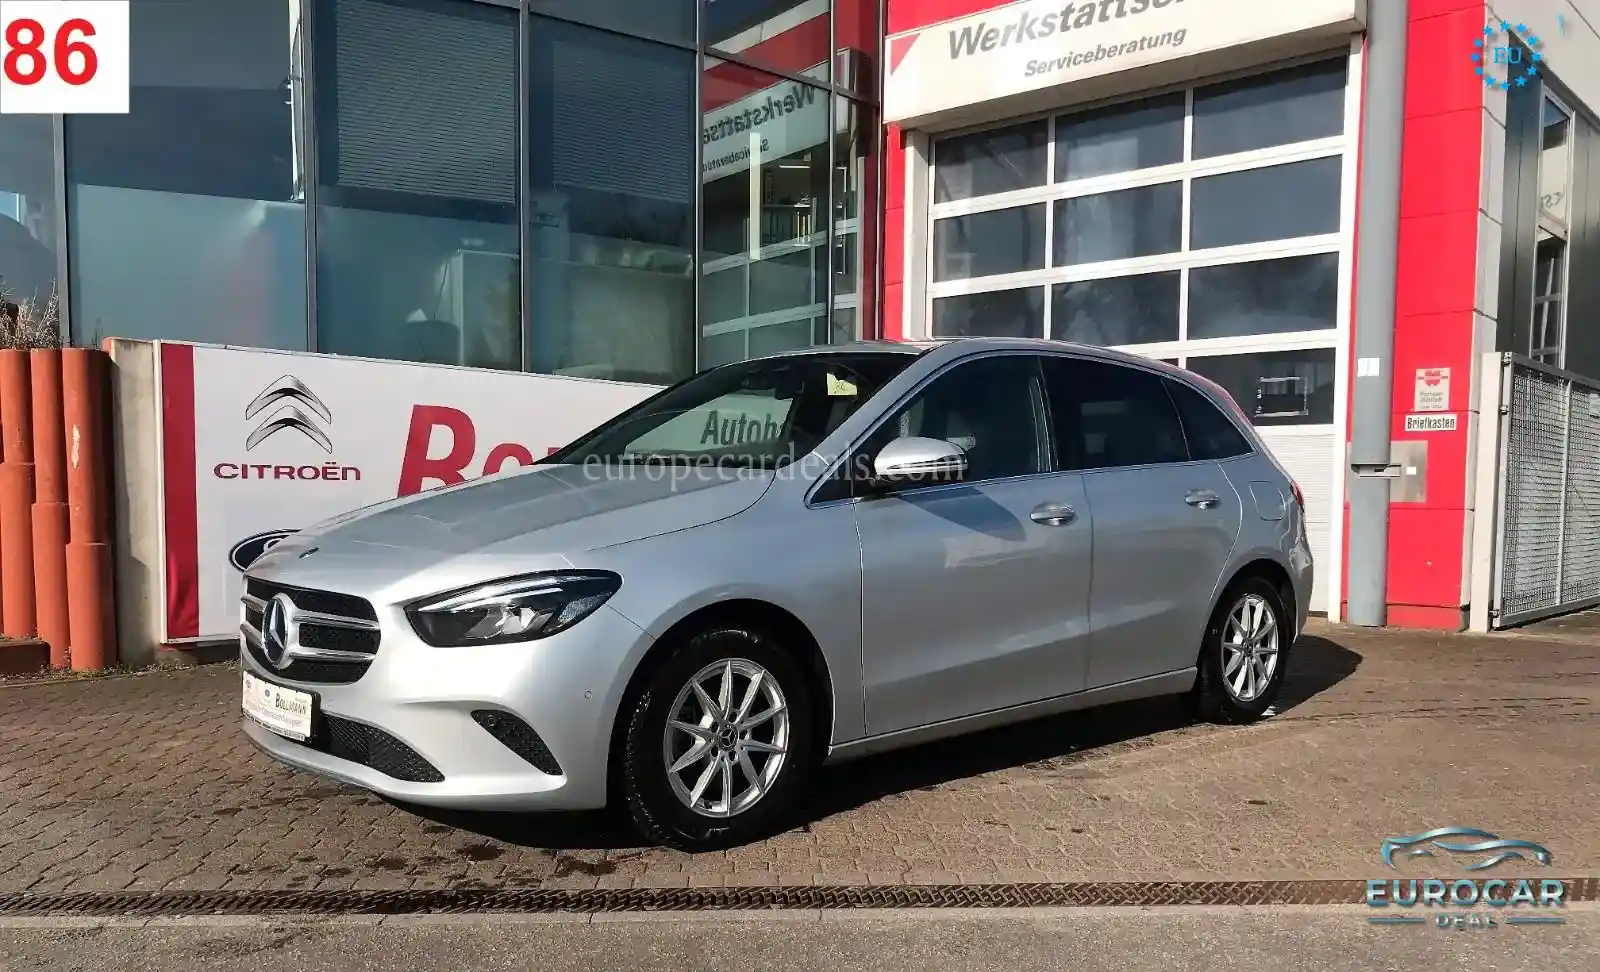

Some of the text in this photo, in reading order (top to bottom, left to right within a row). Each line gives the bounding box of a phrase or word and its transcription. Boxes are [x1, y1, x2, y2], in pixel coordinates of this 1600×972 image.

[1024, 28, 1187, 77] Serviceberatung
[700, 410, 783, 446] Autoh
[1407, 416, 1455, 430] Briefkasten
